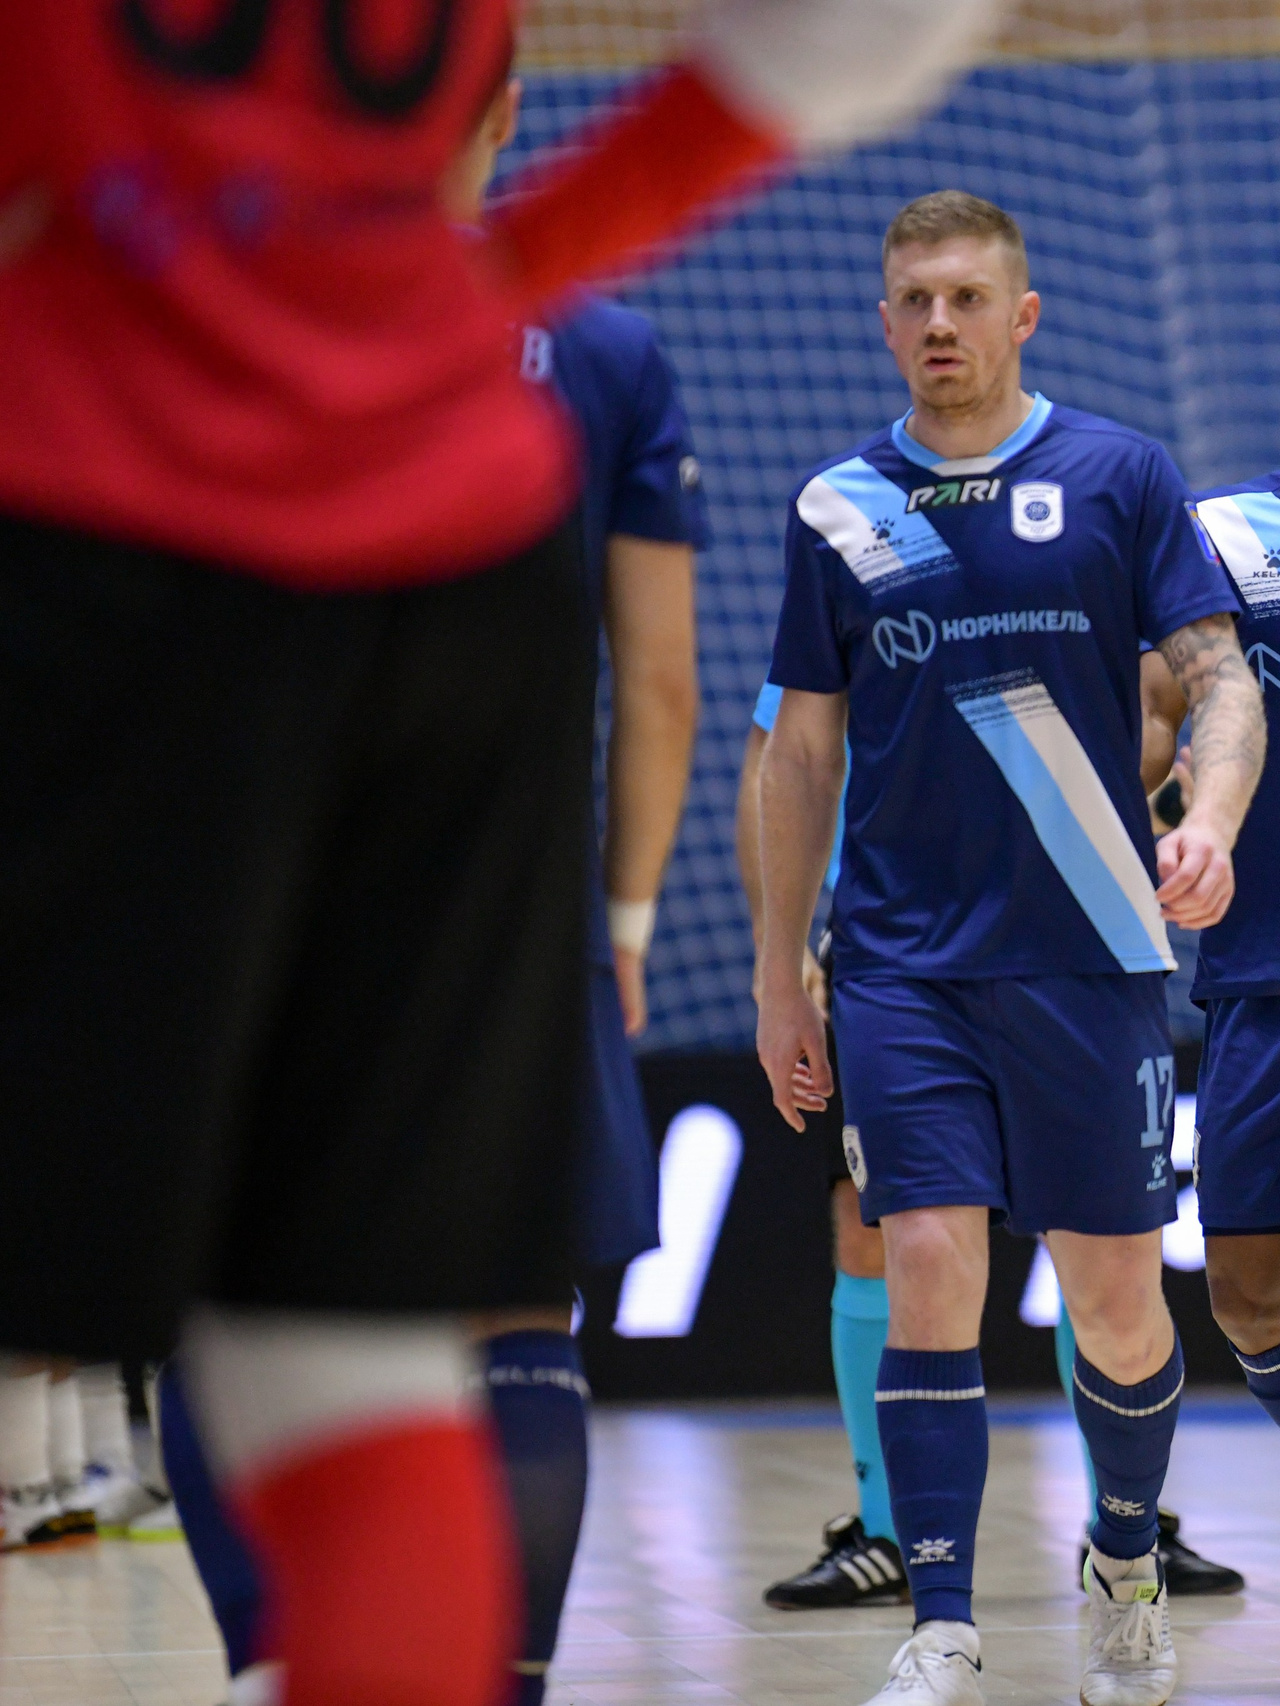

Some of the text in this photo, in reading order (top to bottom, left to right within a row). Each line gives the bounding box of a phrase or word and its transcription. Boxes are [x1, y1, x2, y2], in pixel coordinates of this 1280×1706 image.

[906, 478, 1002, 513] PARI
[941, 609, 1092, 642] НОРНИКЕЛЬ
[1136, 1055, 1174, 1149] 17
